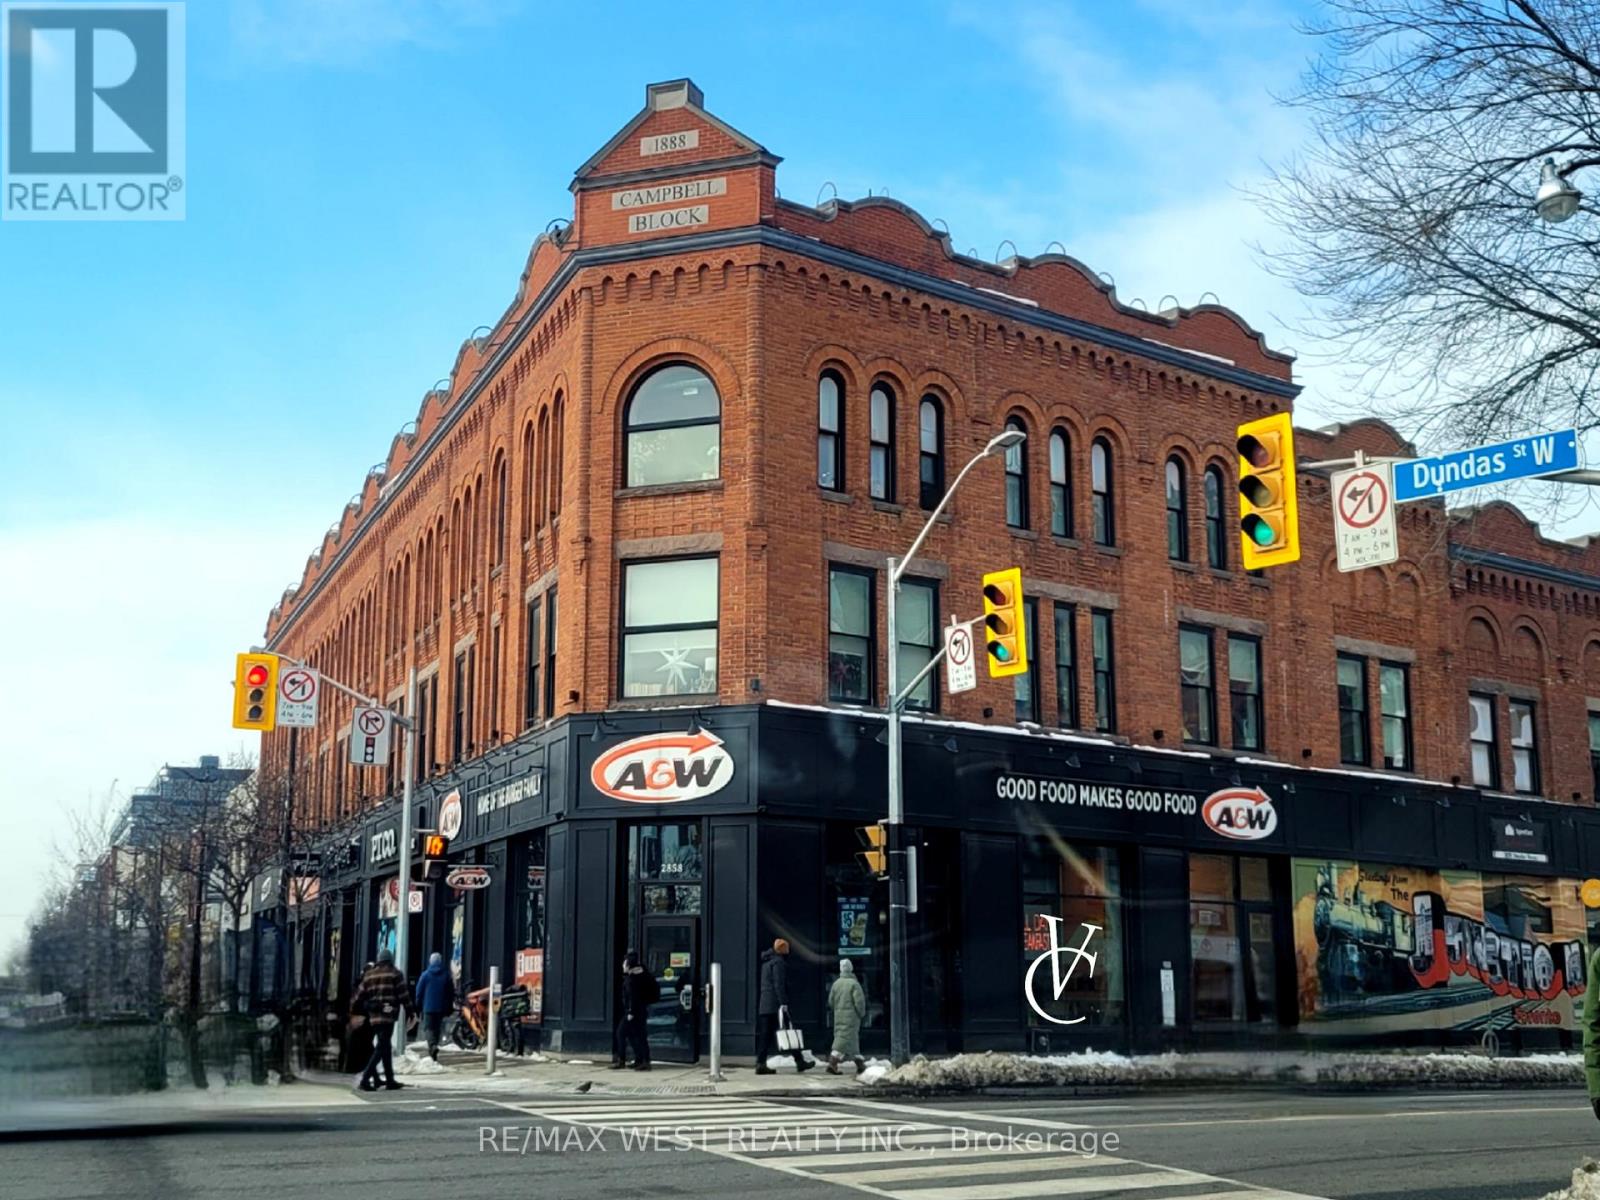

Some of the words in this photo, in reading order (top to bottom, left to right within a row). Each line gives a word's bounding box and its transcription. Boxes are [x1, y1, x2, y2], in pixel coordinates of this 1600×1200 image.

[654, 134, 687, 152] 1888
[619, 180, 719, 208] CAMPBELL
[634, 207, 702, 232] BLOCK
[1413, 452, 1506, 489] Dundas
[1513, 443, 1527, 458] St
[1532, 436, 1555, 466] W
[1343, 533, 1348, 544] 7
[1371, 528, 1377, 538] 9
[1373, 541, 1379, 551] 6
[609, 756, 725, 791] A&W
[997, 777, 1036, 801] GOOD
[1039, 781, 1077, 804] FOOD
[1079, 784, 1123, 809] MAKES
[1125, 789, 1162, 812] GOOD
[1164, 791, 1197, 815] FOOD
[1215, 806, 1271, 831] A&W
[661, 863, 683, 873] 2858
[1390, 887, 1409, 901] The
